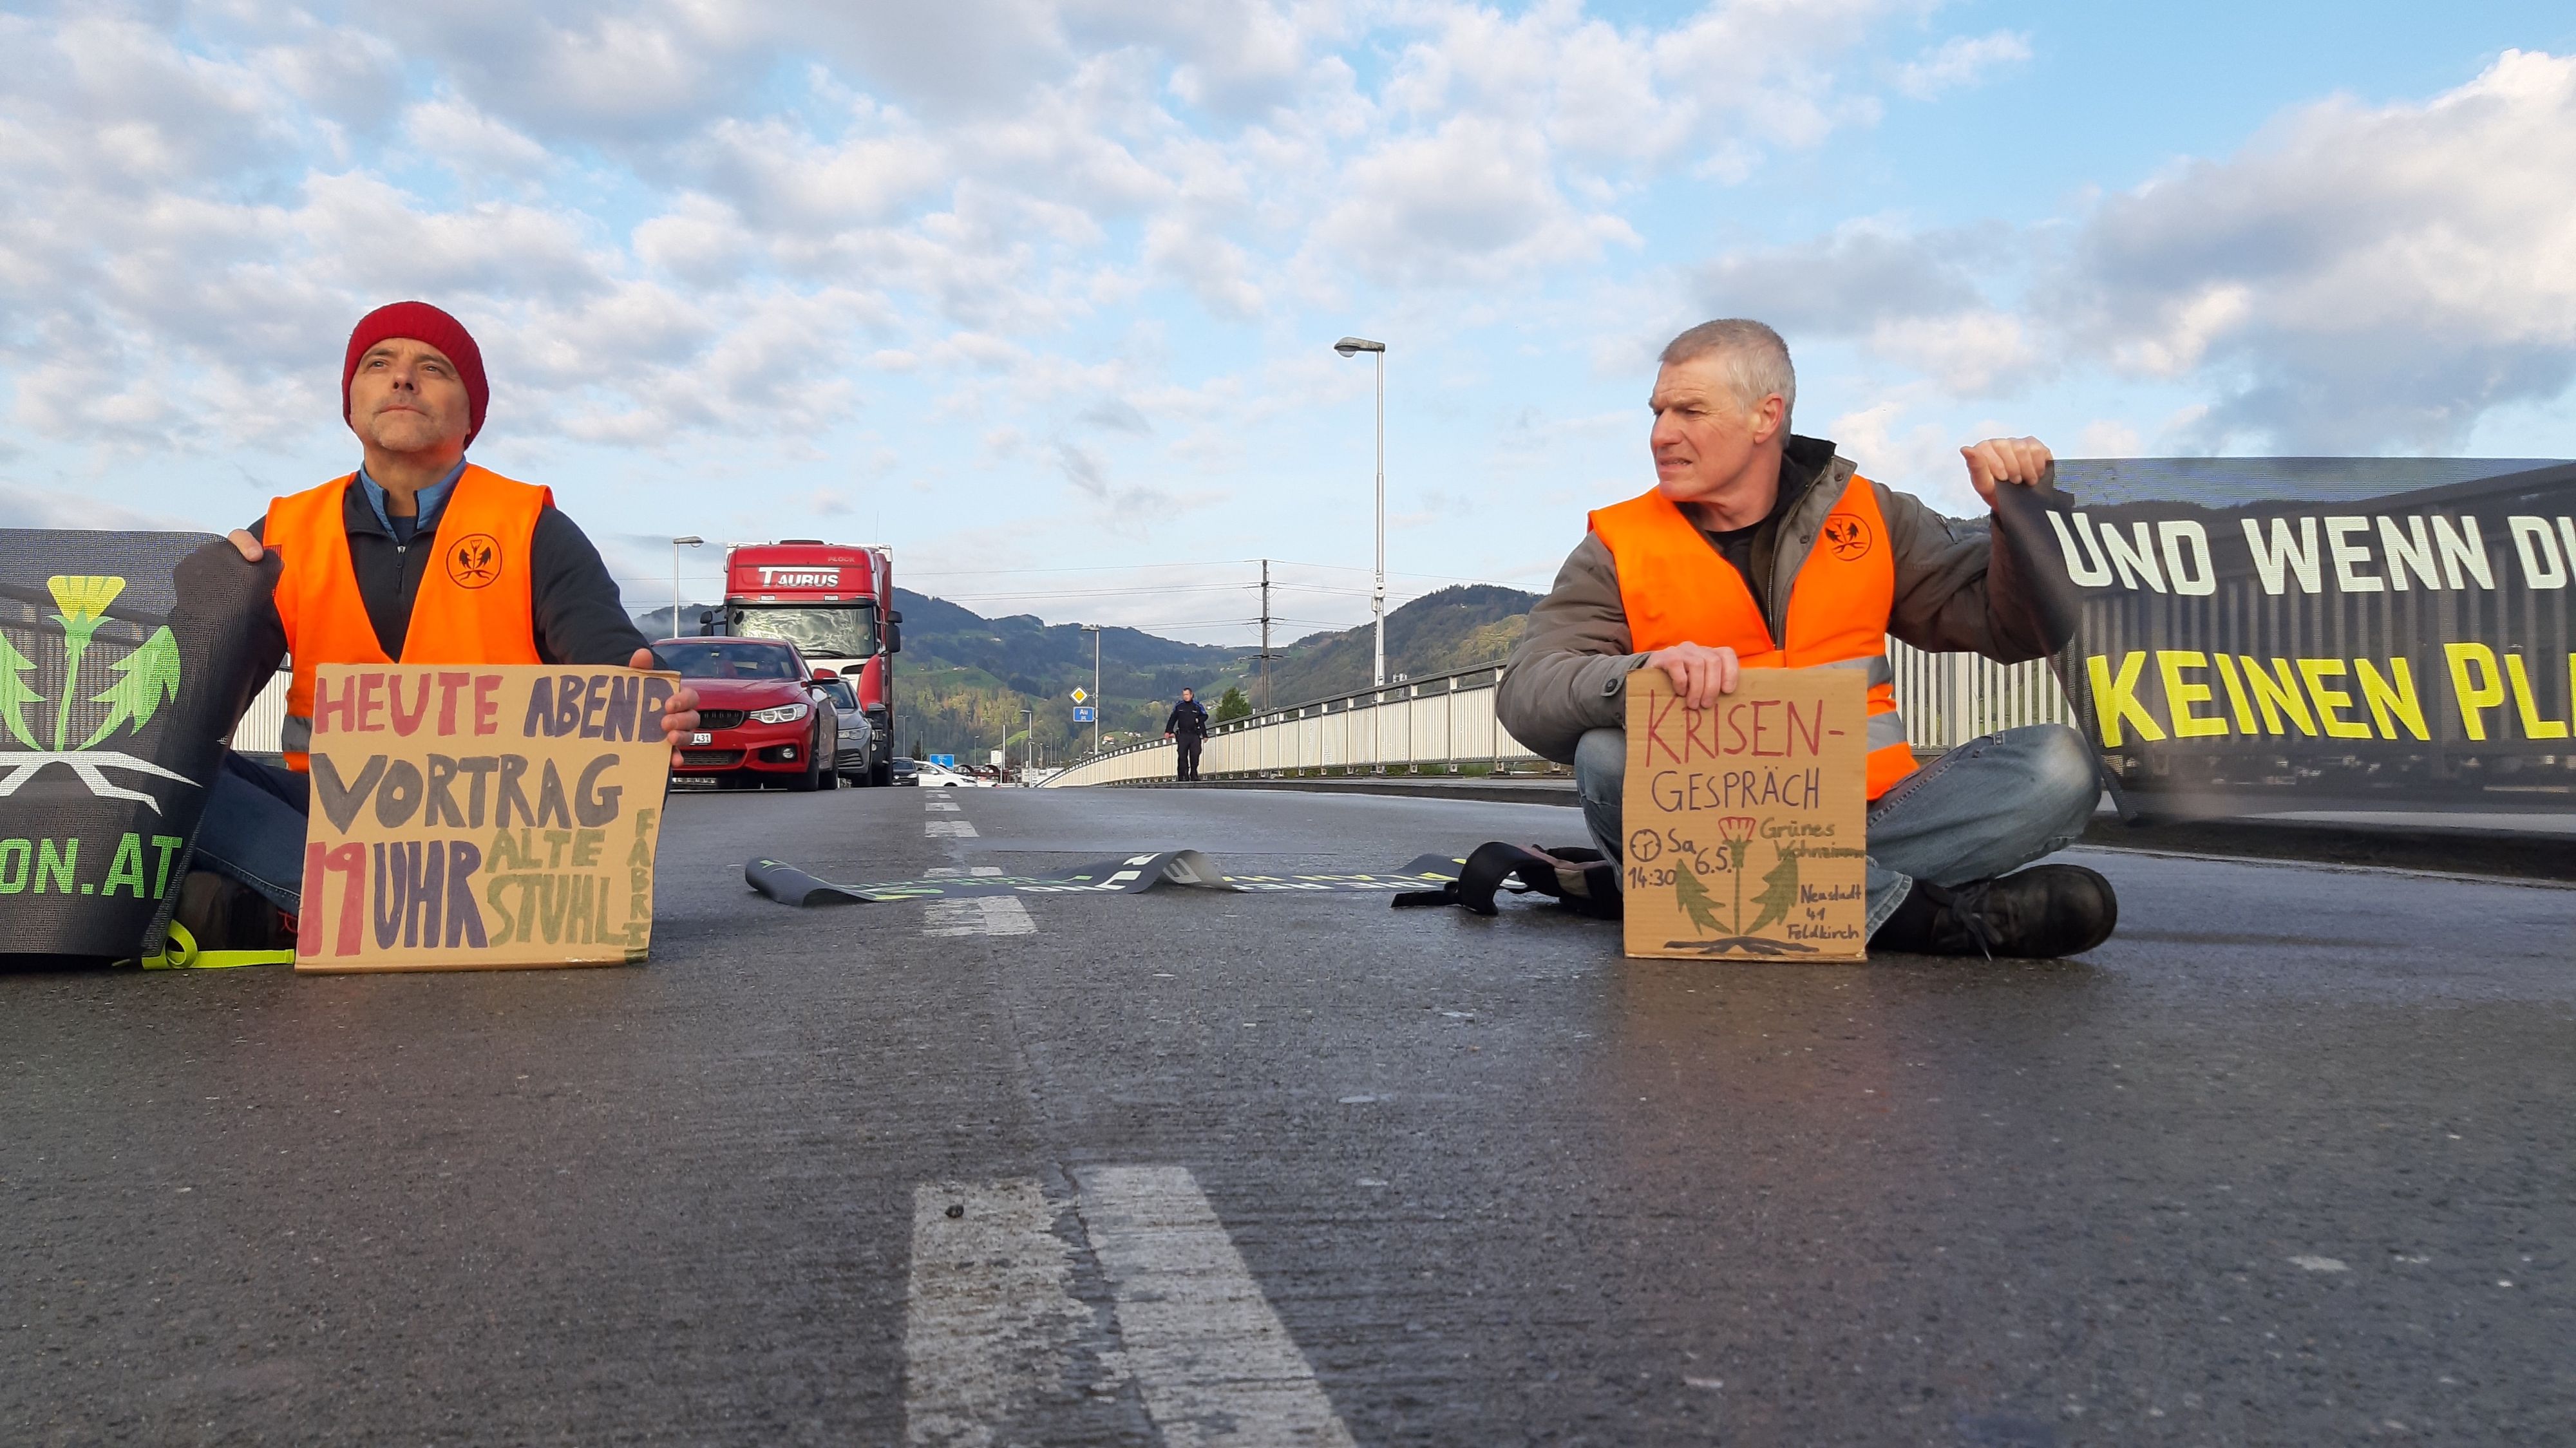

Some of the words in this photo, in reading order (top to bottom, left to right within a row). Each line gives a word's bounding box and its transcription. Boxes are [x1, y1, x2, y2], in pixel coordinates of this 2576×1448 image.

[2045, 509, 2217, 596] UND
[2240, 515, 2496, 596] WENN
[758, 567, 842, 587] TAURUS
[315, 672, 504, 737] HEUTE
[523, 674, 676, 743] ABEND
[2087, 650, 2431, 749] KEINEN
[2443, 643, 2576, 742] PL
[1645, 688, 1845, 767] KRISEN-
[309, 753, 623, 835] VORTRAG
[1651, 766, 1821, 812] GESPRÄCH
[485, 827, 606, 874] ALTE
[1759, 816, 1835, 839] Grünes
[1627, 865, 1676, 889] 14:30
[1694, 847, 1732, 876] 6.5.
[297, 842, 366, 957] 19
[374, 840, 488, 950] UHR
[487, 874, 629, 948] STUHL
[1806, 907, 1825, 921] 41
[1787, 924, 1859, 940] Feldkirch
